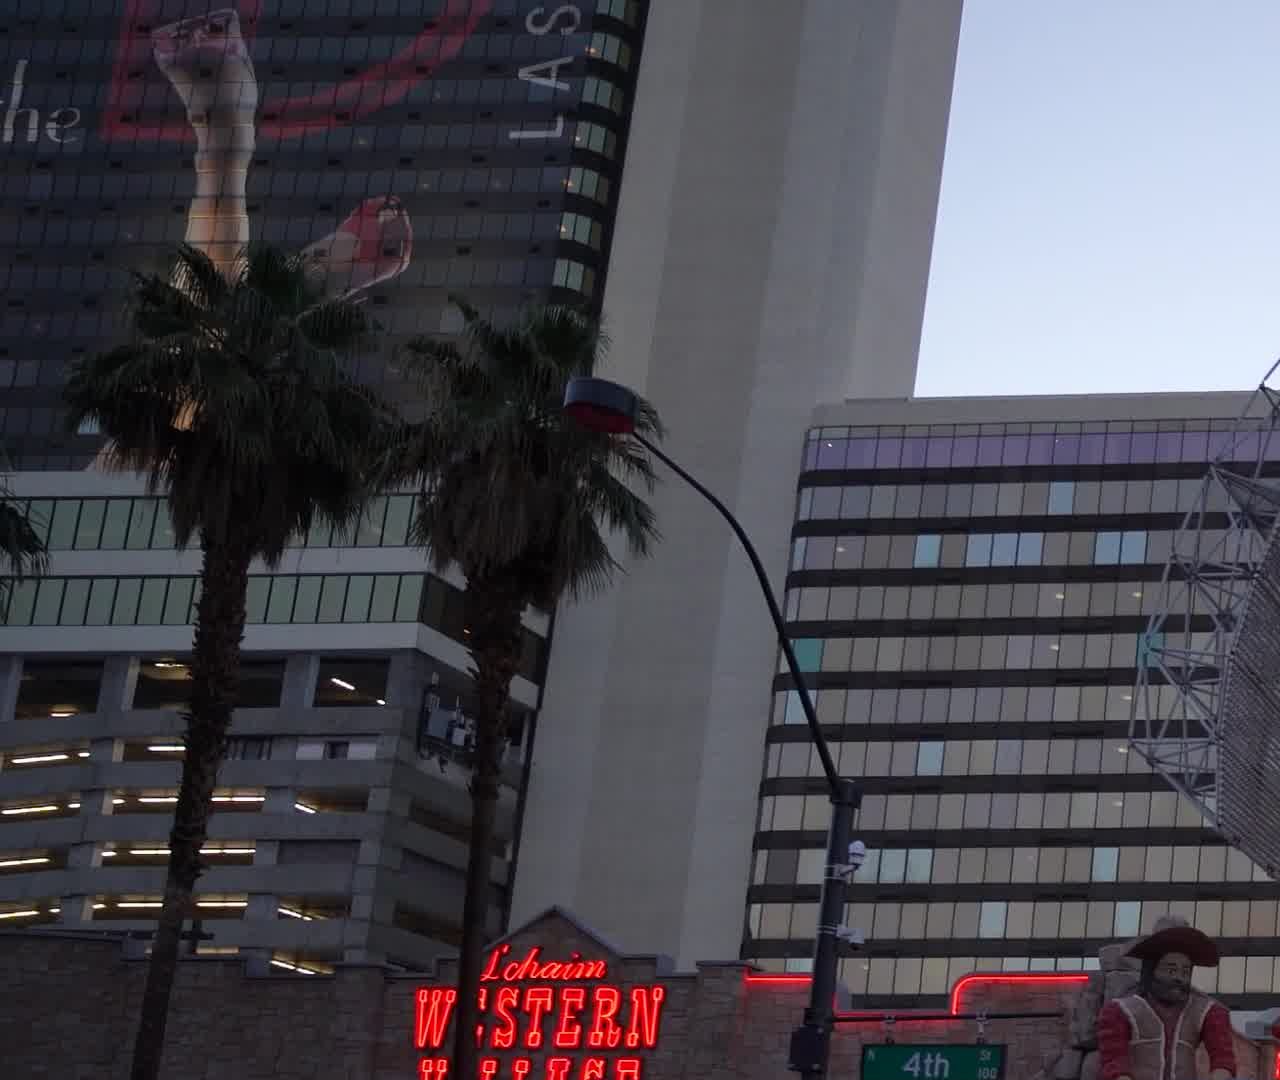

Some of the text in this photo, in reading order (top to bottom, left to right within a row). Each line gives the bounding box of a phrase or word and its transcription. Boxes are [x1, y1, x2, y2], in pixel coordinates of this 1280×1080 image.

[508, 4, 582, 140] LAS
[0, 58, 82, 143] he
[480, 944, 606, 982] L'chaim
[903, 1051, 950, 1078] 4th
[979, 1050, 992, 1061] St
[977, 1067, 998, 1080] 100
